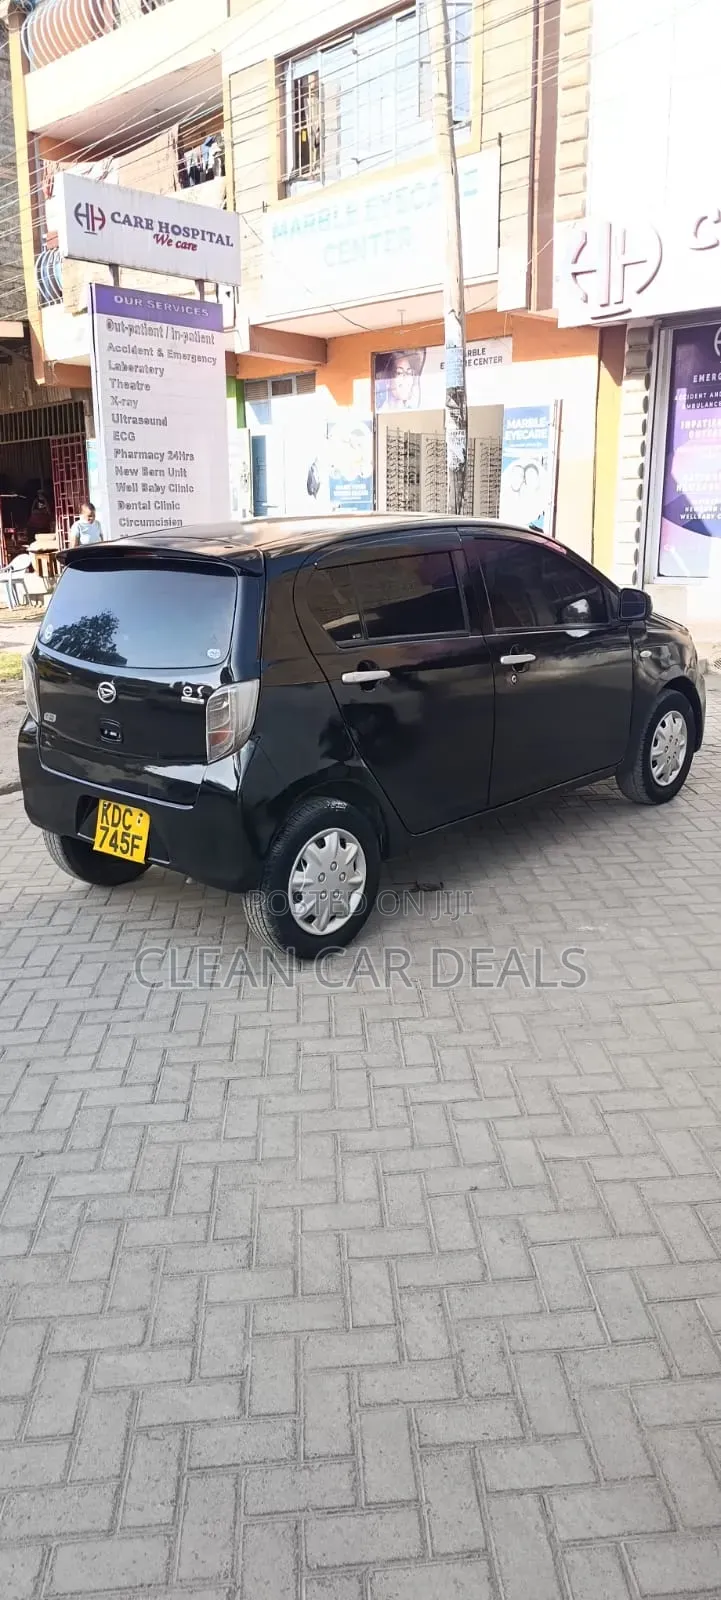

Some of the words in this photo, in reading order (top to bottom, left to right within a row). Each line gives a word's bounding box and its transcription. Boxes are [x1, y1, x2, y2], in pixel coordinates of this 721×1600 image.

[110, 211, 154, 231] CARE
[158, 221, 234, 247] HOSPITAL
[153, 233, 173, 247] We
[175, 239, 198, 251] care
[113, 295, 142, 306] OUR
[146, 300, 209, 317] SERVICES
[105, 318, 164, 338] Out-patient
[171, 327, 215, 345] In-patient
[106, 342, 154, 356] Accident
[167, 349, 217, 366] Emergency
[473, 355, 503, 366] CENTER
[108, 359, 165, 378] Laboratory
[109, 378, 151, 391] Theatre
[110, 395, 139, 409] X-ray
[111, 413, 168, 427] Ultrasound
[112, 431, 136, 442] ECG
[113, 448, 165, 462] Pharmacy
[167, 450, 195, 461] 24Hrs
[114, 466, 139, 477] New
[168, 467, 188, 478] Unit
[115, 482, 139, 492] Well
[141, 482, 166, 494] Baby
[168, 483, 195, 493] Clinic
[117, 500, 151, 511] Dental
[154, 500, 181, 511] Clinic
[118, 517, 183, 527] Circumcision
[101, 802, 133, 831] KDC
[99, 825, 143, 857] 745F
